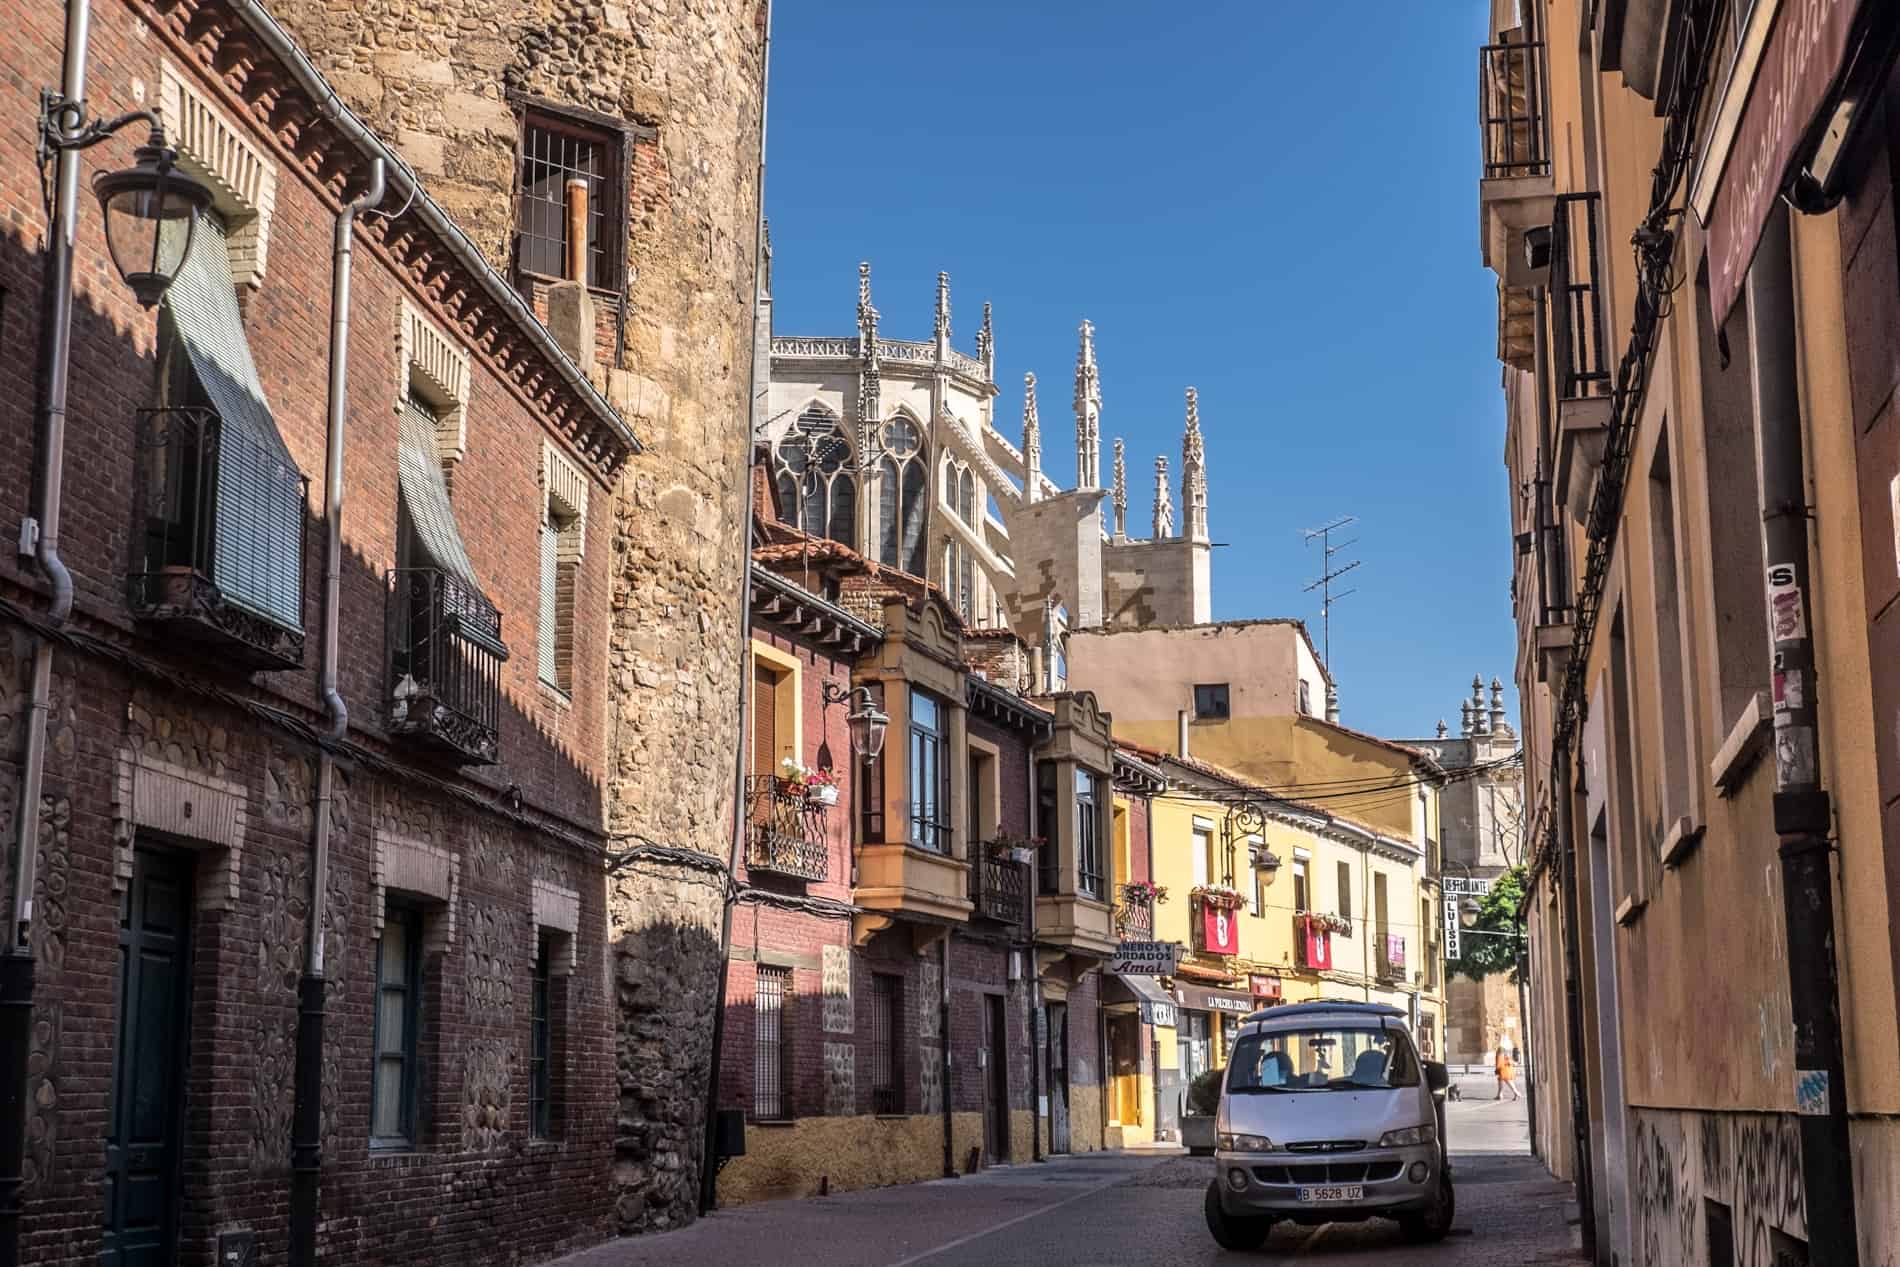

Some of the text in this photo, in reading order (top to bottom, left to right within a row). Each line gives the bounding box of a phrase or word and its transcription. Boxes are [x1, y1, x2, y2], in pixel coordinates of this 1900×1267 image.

[1445, 879, 1488, 894] RESTAUANTE
[1114, 951, 1172, 960] ORDADOS
[1112, 960, 1166, 973] Amal
[1302, 1186, 1360, 1200] B 5628 UZ
